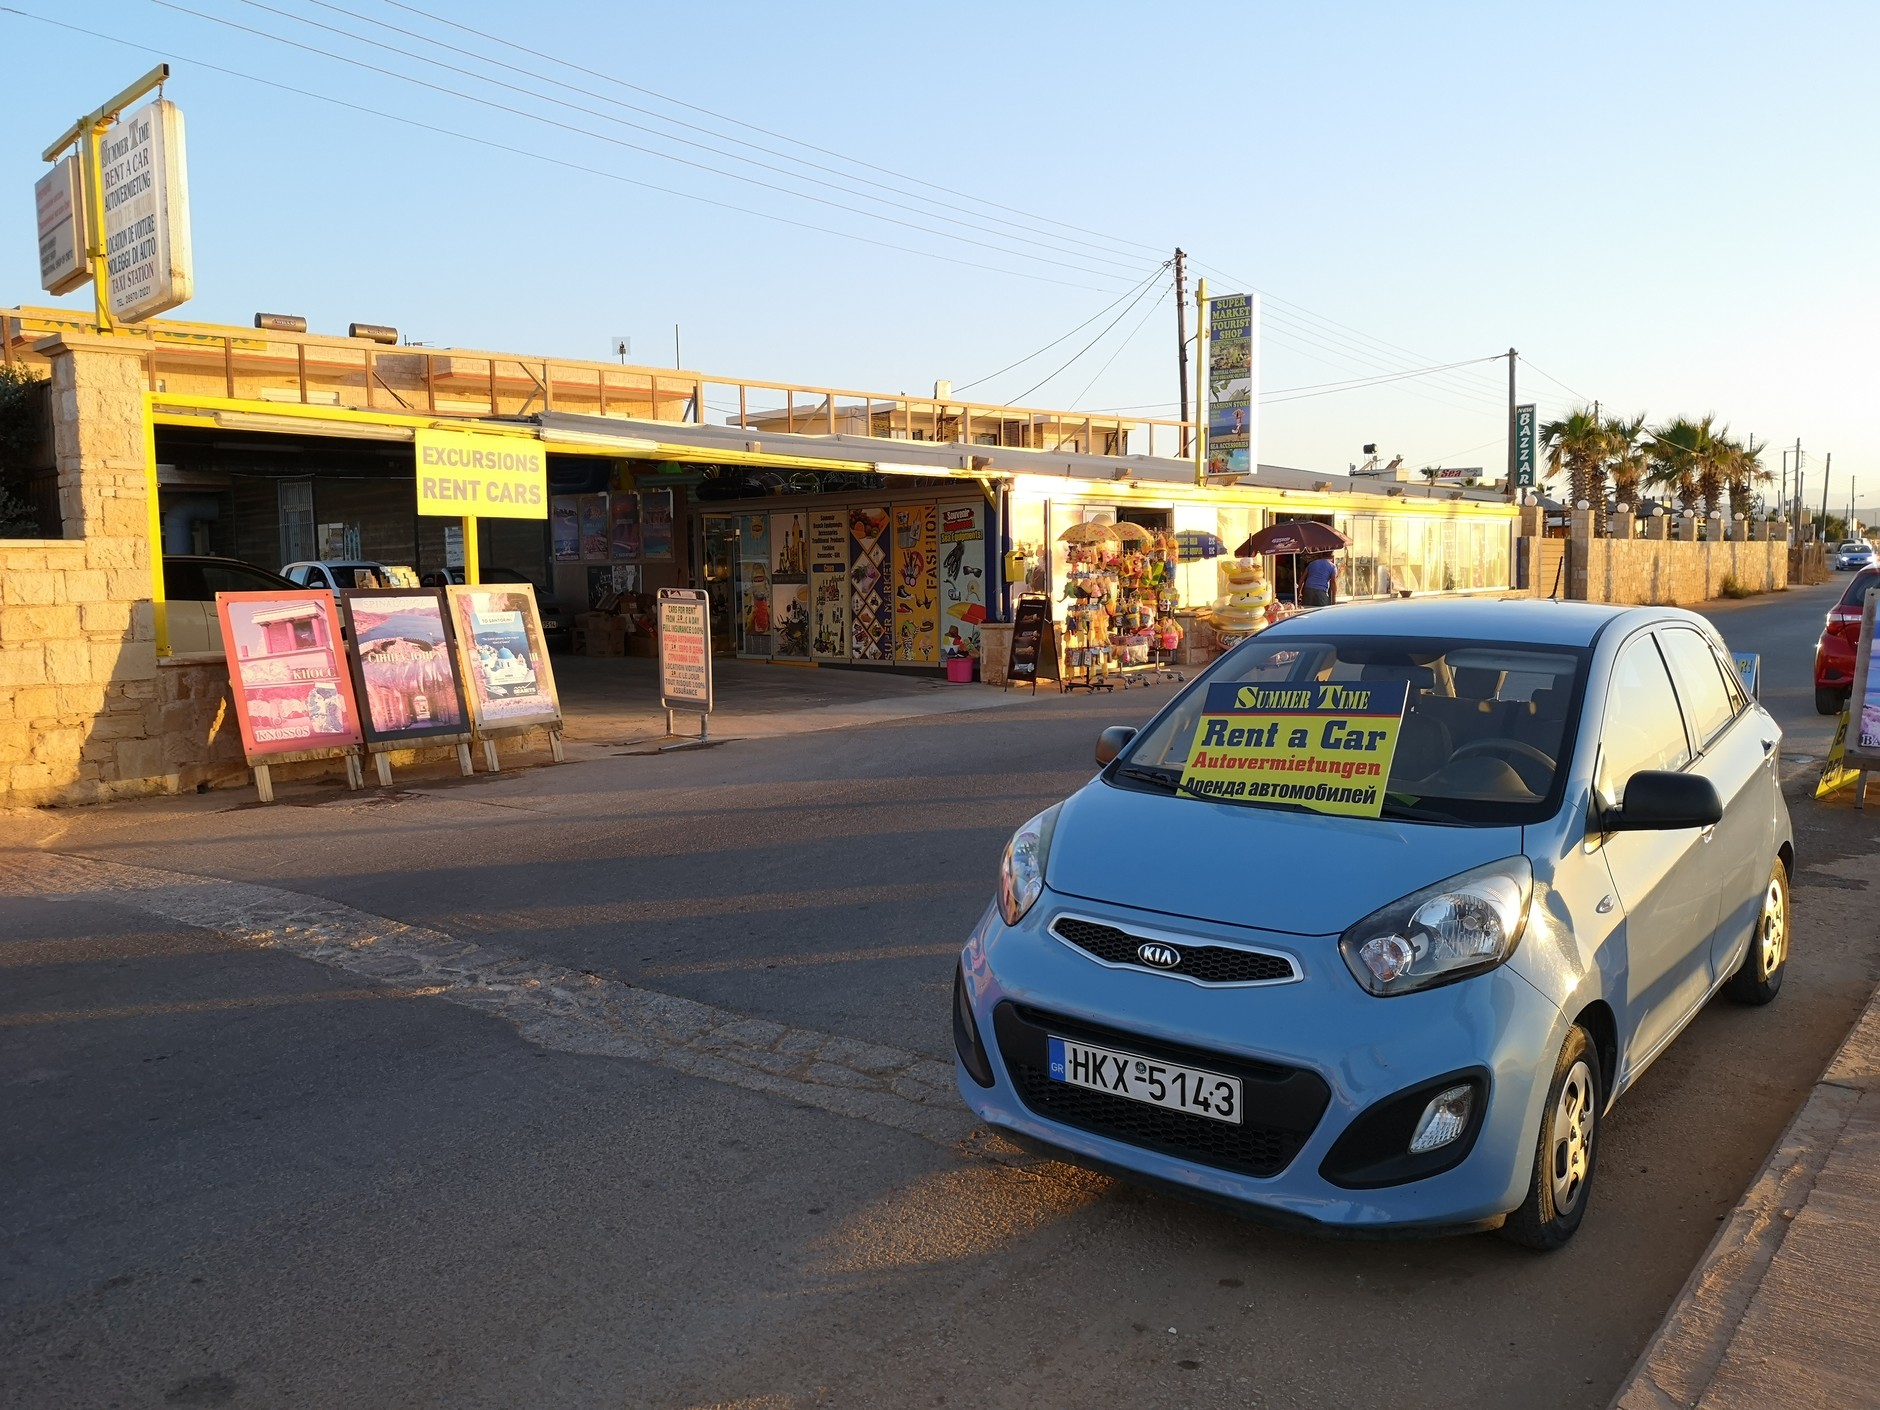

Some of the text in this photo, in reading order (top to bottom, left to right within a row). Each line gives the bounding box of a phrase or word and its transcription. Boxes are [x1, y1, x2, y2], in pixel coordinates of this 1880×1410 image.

[129, 118, 150, 151] TIME
[105, 147, 149, 190] RENT A CAR
[105, 170, 151, 213] AUTOVERMIETUNG
[106, 213, 155, 256] LOCATION DE VOITURE
[132, 245, 138, 265] DI
[140, 236, 156, 260] AUTO
[112, 260, 155, 294] TAXI STATION
[1216, 295, 1246, 309] SUPER
[1212, 307, 1250, 320] MARKET
[1212, 318, 1250, 331] TOURIST
[1219, 329, 1243, 339] SHOP
[1211, 402, 1232, 410] FASHION
[1220, 441, 1249, 449] ACCESSORIES
[1519, 413, 1531, 484] BAZZAR
[423, 446, 540, 473] EXCURSIONS
[1441, 469, 1462, 478] Sea
[423, 477, 541, 505] RENT CARS
[946, 509, 970, 520] Souvenir
[925, 505, 937, 590] FASHION
[668, 605, 696, 615] CARS FOR RENT
[671, 625, 692, 634] INSURANCE
[665, 663, 704, 673] LOCATION VOITURE
[665, 678, 676, 686] TOUT
[673, 687, 697, 696] ASSURANCE
[1233, 685, 1371, 710] SUMMER TIME
[256, 727, 310, 742] KNOSSOS
[1200, 719, 1386, 752] Rent a Car
[1191, 752, 1381, 780] Autovermietungen
[1183, 777, 1377, 805] Аренда автомобилей
[1143, 946, 1172, 964] KIA
[1051, 1062, 1064, 1074] GR
